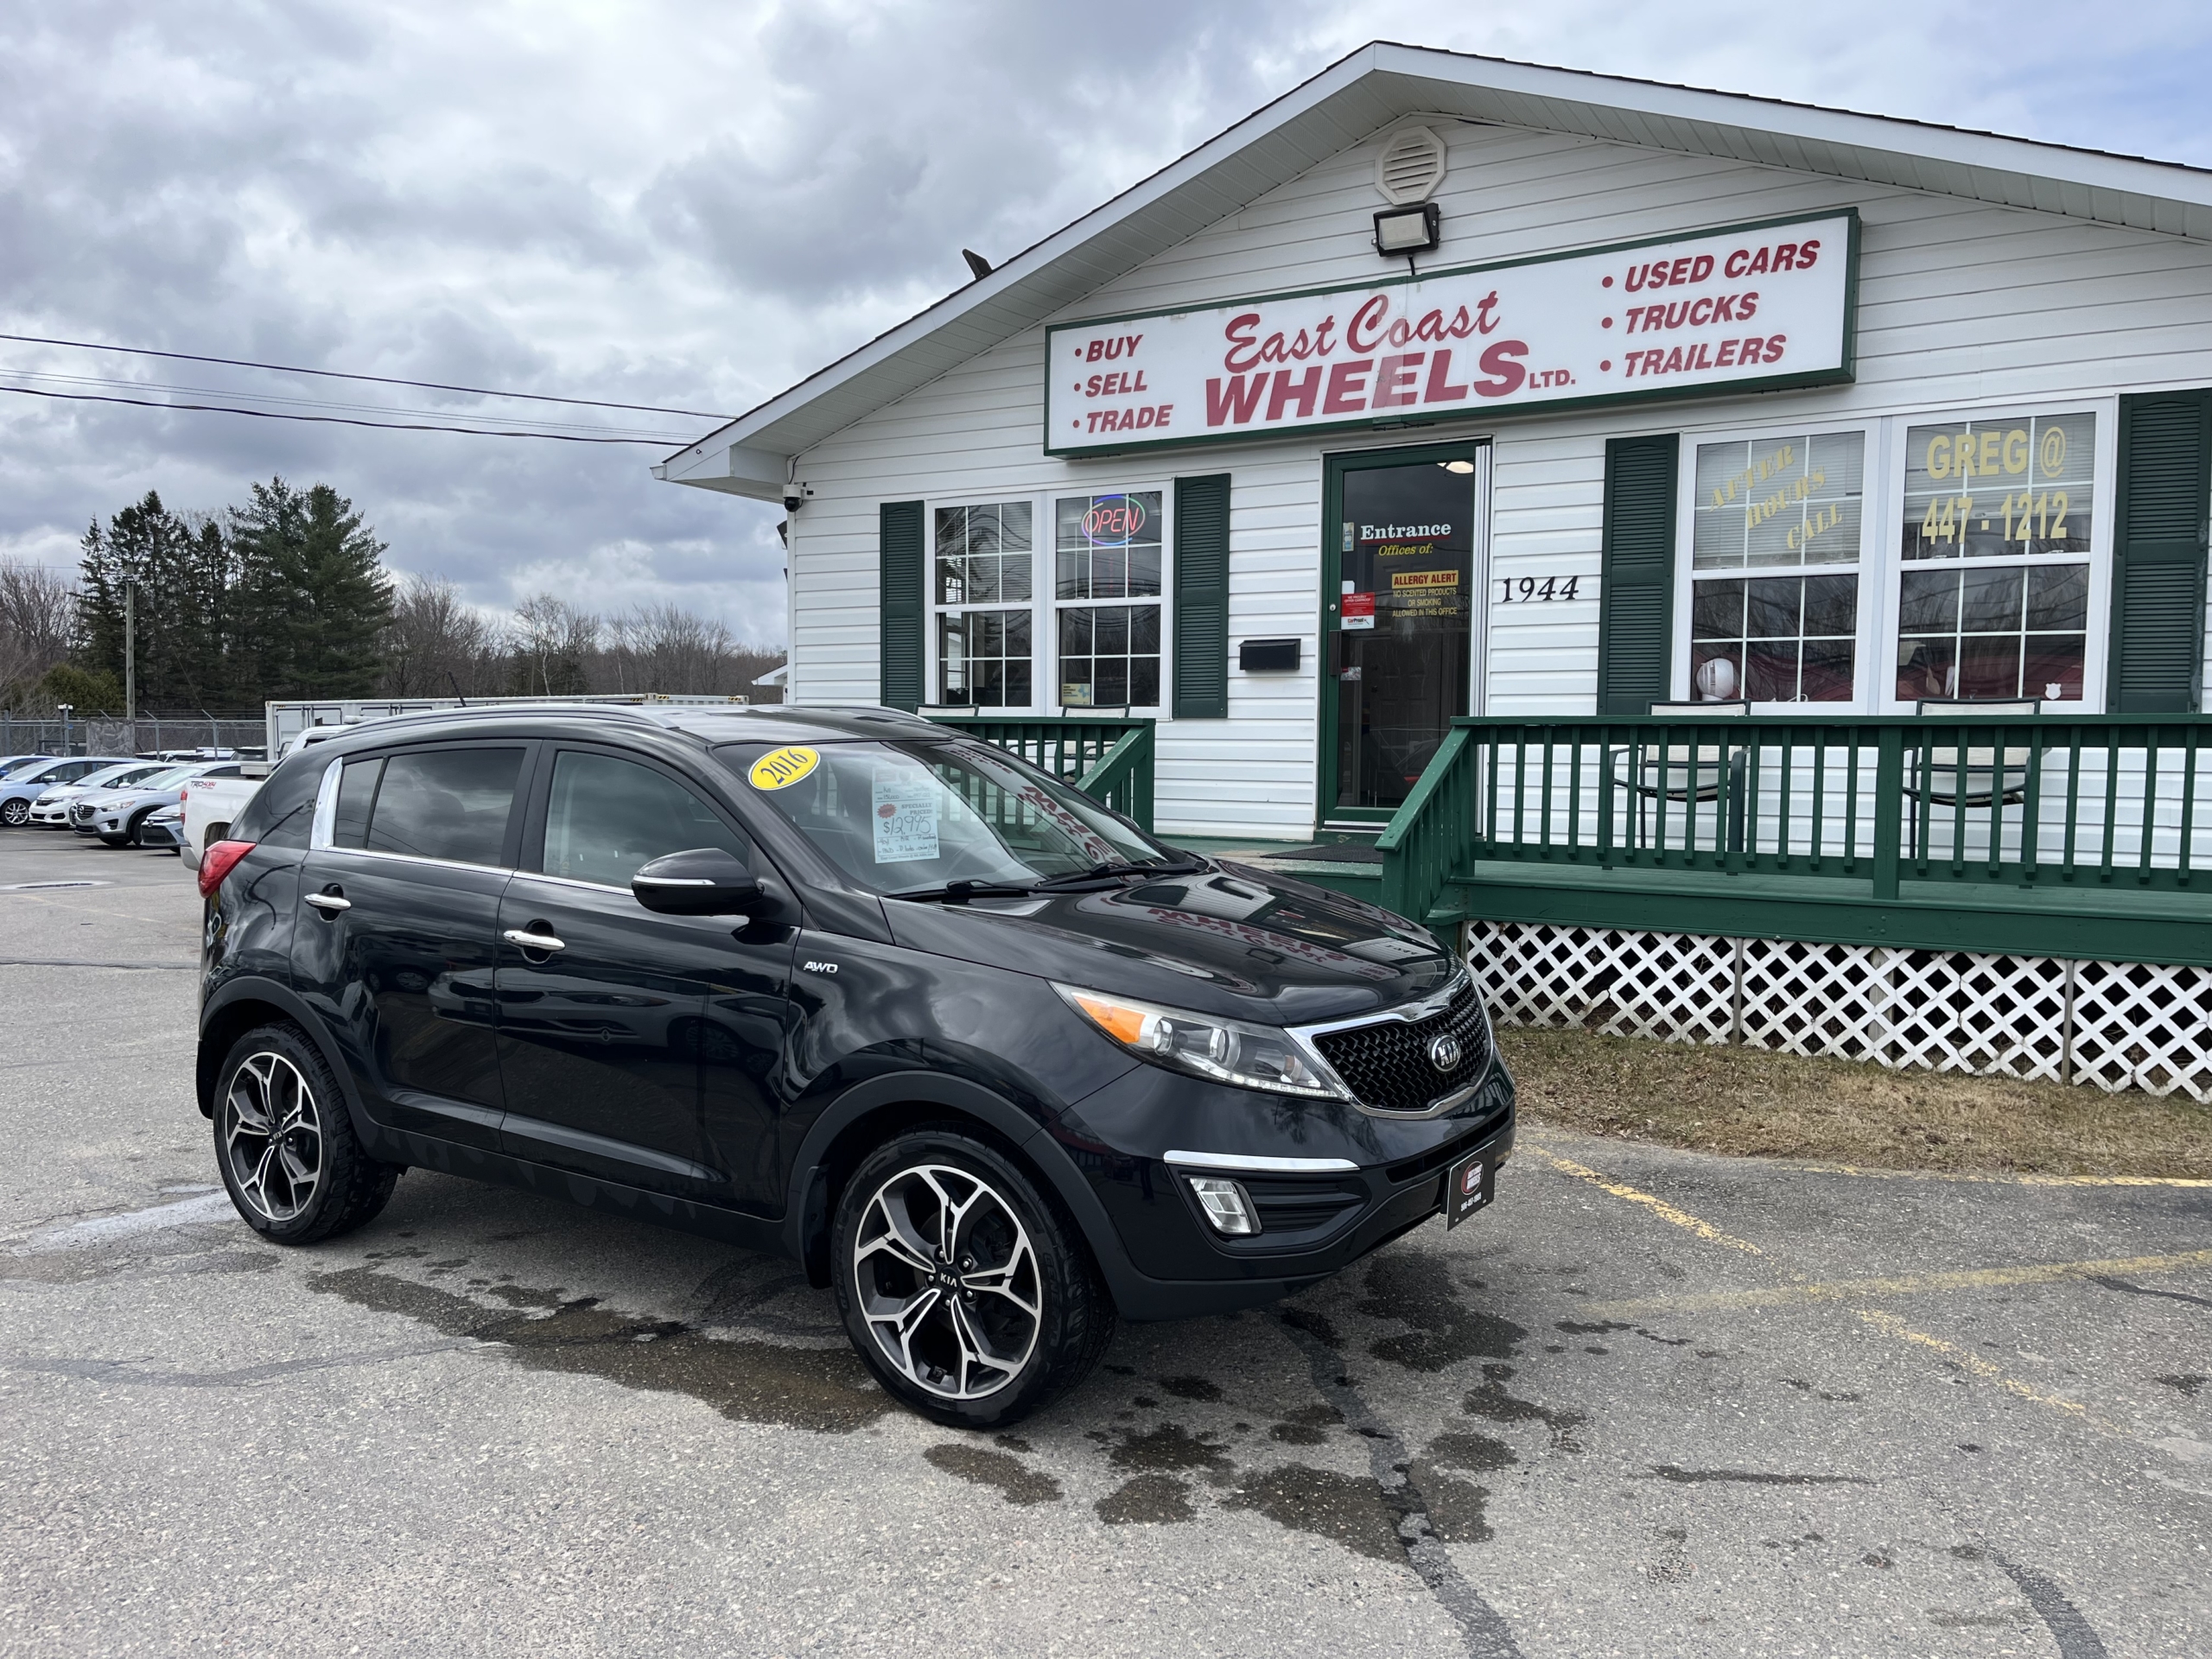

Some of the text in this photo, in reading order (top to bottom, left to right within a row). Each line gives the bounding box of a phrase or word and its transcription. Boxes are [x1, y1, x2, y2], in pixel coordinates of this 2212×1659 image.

[1624, 240, 1821, 292] USED CARS
[1625, 292, 1759, 334] TRUCKS
[1224, 294, 1501, 373] East Coast
[1085, 334, 1144, 363] BUY
[1624, 334, 1787, 378] TRAILERS
[1085, 370, 1147, 397] SELL
[1205, 340, 1577, 428] WHEELS LTD.
[1086, 404, 1174, 434] TRADE
[1926, 426, 2067, 480] GREG @
[1709, 445, 1796, 513] AFTER
[1746, 466, 1826, 531] HOURS
[1084, 507, 1140, 533] OPEN
[1360, 524, 1452, 540] Entrance
[1786, 503, 1844, 550] CALL
[1922, 497, 1974, 545] 447
[2000, 491, 2069, 541] 1212
[1378, 543, 1434, 556] Offices of:
[1394, 573, 1457, 586] ALLERGY ALERT
[1402, 588, 1427, 598] SCENTED
[1427, 588, 1457, 596] PRODUCTS
[1502, 575, 1580, 603] 1944
[1392, 608, 1418, 617] ALLOWED
[1438, 607, 1458, 615] OFFICE
[1417, 598, 1441, 607] SMOKING
[760, 748, 809, 785] 2016
[803, 961, 838, 974] AWD
[1438, 1041, 1460, 1066] KIA
[940, 1272, 957, 1287] KIA
